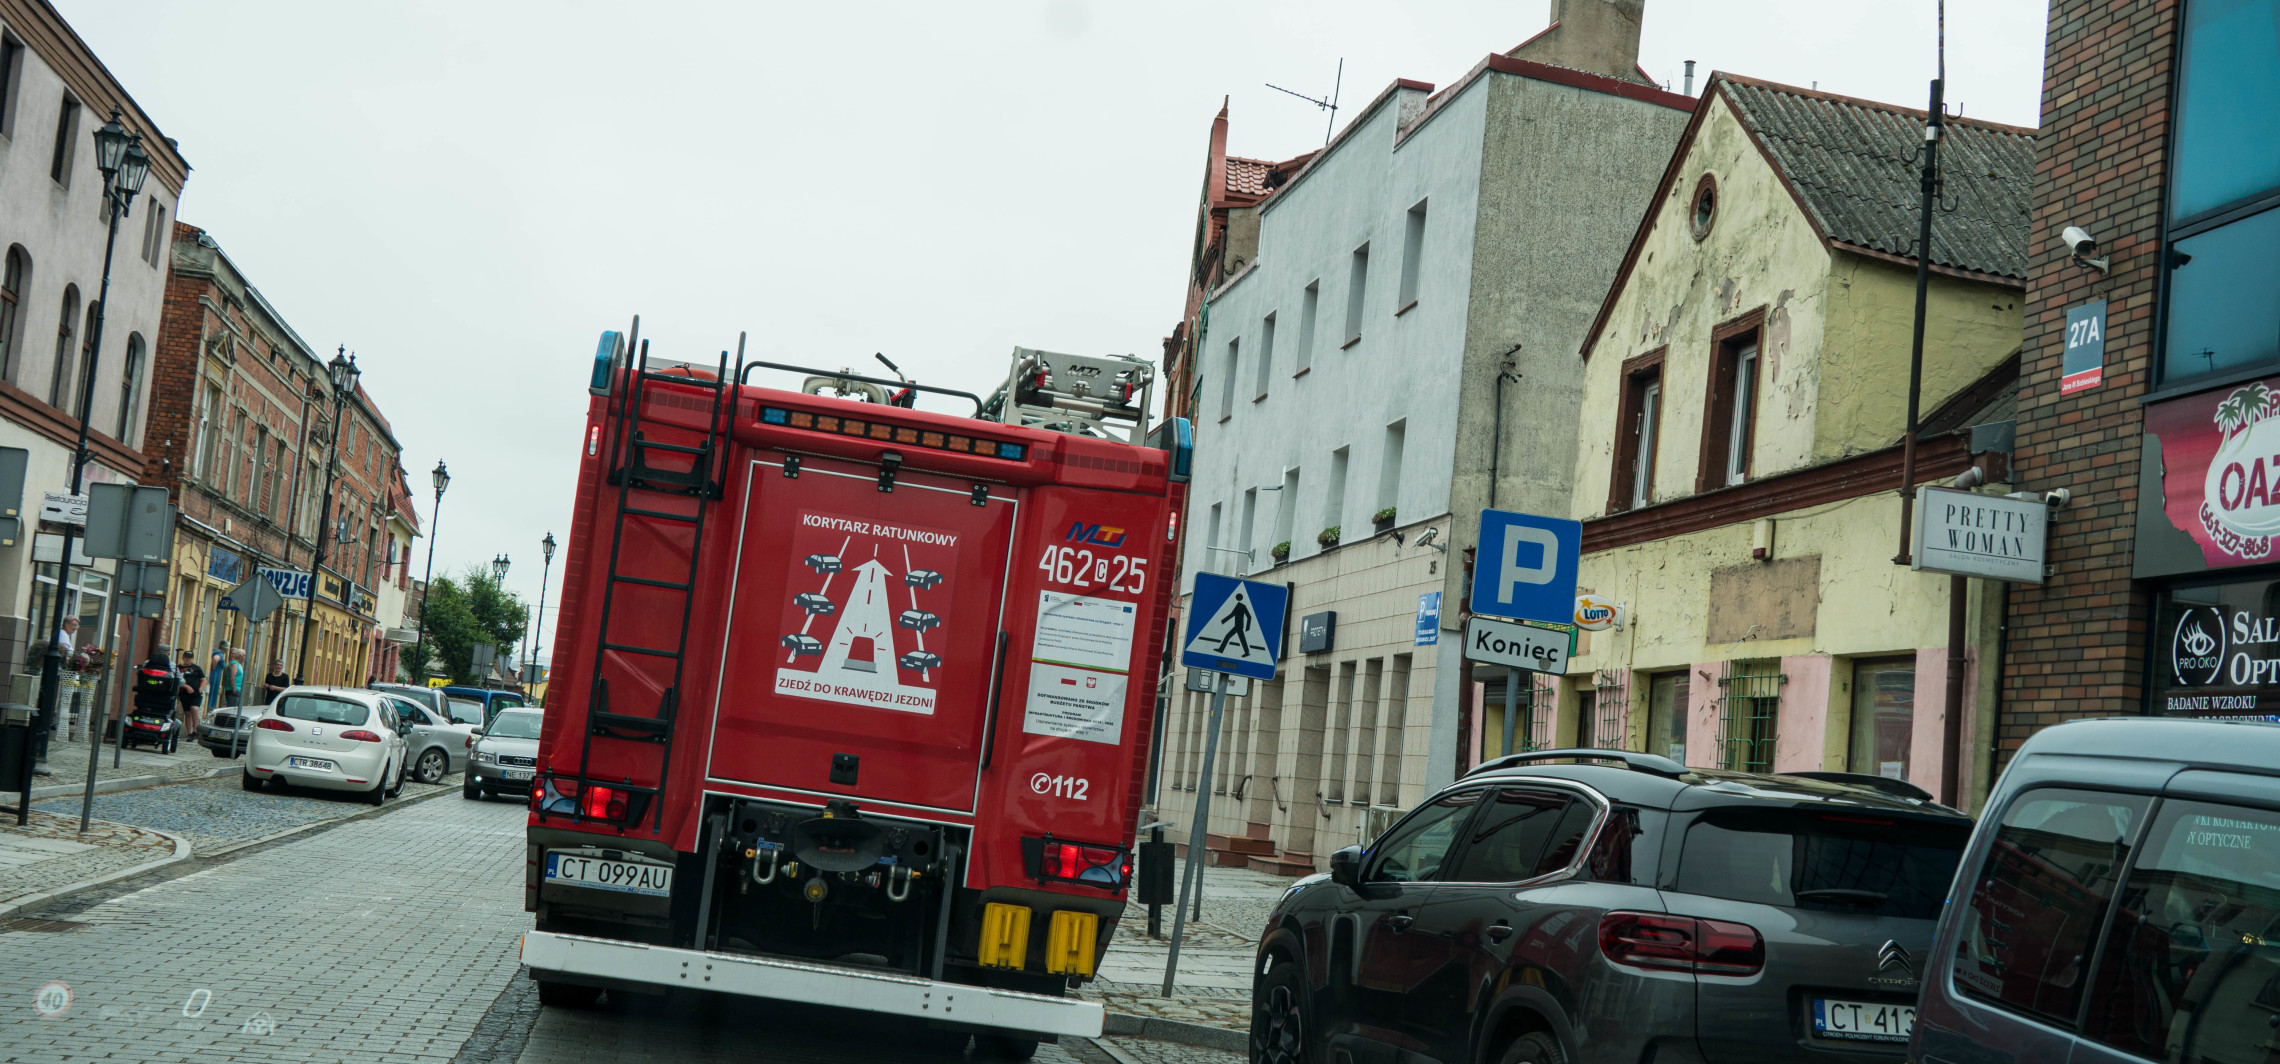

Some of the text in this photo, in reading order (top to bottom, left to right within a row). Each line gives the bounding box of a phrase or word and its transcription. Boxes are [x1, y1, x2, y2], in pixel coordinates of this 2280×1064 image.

[2069, 316, 2100, 348] 27A
[2077, 376, 2100, 387] Sobieskiego
[45, 493, 87, 506] Restauracja
[803, 513, 957, 547] KORYTARZ RATUNKOWY
[1945, 503, 2029, 533] PRETTY
[1948, 528, 2024, 557] WOMAN
[1497, 524, 1559, 604] P
[1949, 553, 2020, 566] SALON KOSMETYCZNY
[261, 569, 313, 598] RYZJE
[1584, 608, 1609, 619] LOTTO
[1476, 629, 1559, 662] Koniec
[2179, 656, 2217, 669] PRO OKO
[778, 677, 933, 708] ZJEDŹ DO KRAWĘDZI JEZDNI
[2167, 695, 2256, 710] BADANIE WZROKU
[293, 757, 332, 770] CTR 38648
[1052, 775, 1089, 800] 112
[2198, 832, 2252, 849] OPTYCZNE
[562, 858, 591, 880] CT
[598, 862, 667, 889] 099AU
[1816, 1019, 1825, 1027] PL
[1831, 1003, 1862, 1031] CT
